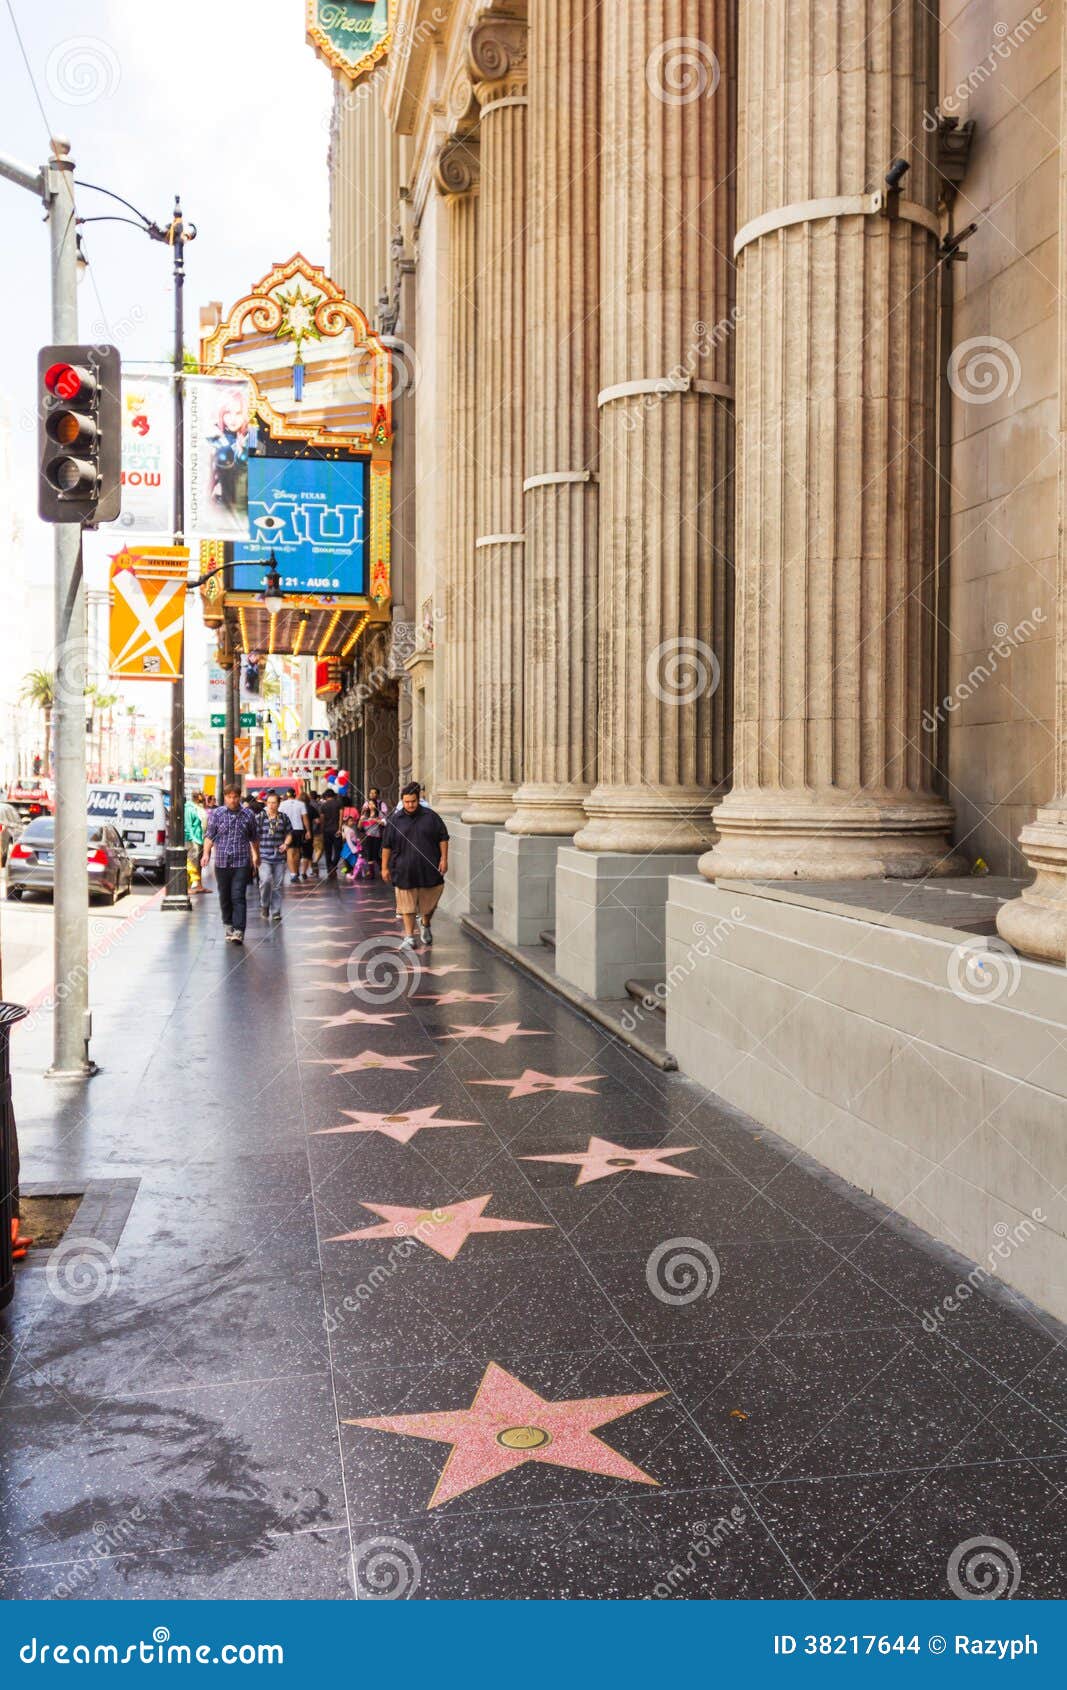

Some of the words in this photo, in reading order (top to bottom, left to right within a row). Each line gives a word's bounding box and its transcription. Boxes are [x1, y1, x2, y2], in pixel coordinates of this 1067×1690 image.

[190, 387, 198, 449] RETURNS
[272, 489, 297, 502] Disney
[301, 492, 326, 500] PIXAR
[247, 501, 363, 547] MU
[285, 577, 298, 587] 21
[306, 578, 330, 588] AUG
